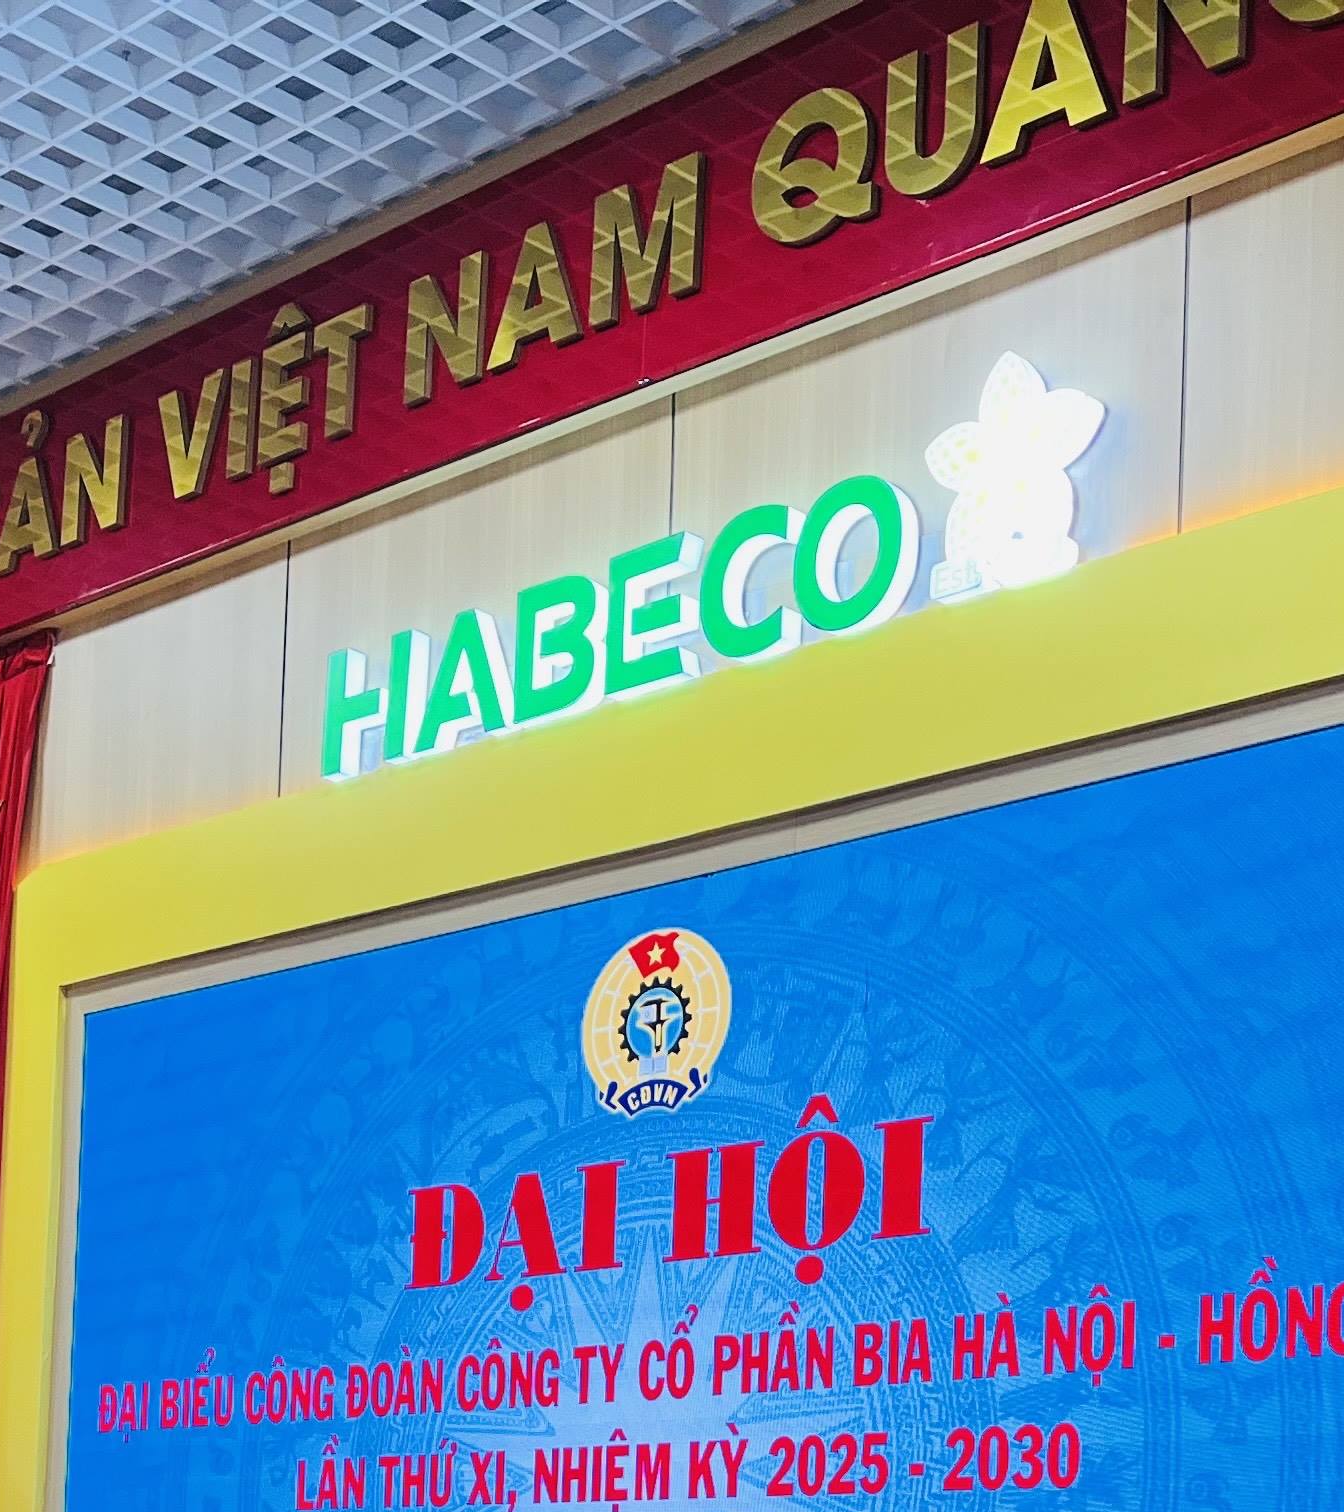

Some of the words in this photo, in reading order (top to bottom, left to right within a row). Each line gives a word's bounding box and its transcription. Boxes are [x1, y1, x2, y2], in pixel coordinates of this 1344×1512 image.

[158, 302, 373, 500] VIỆT
[404, 151, 704, 407] NAM
[320, 474, 918, 781] HABECO
[404, 1159, 627, 1312] ĐẠI
[663, 1093, 936, 1286] HỘI
[98, 1383, 149, 1443] ĐẠI
[160, 1347, 235, 1429] BIỂU
[244, 1356, 335, 1425] CÔNG
[346, 1346, 444, 1420] ĐOÀN
[456, 1339, 560, 1413] CÔNG
[573, 1343, 625, 1405] TY
[638, 1304, 699, 1401] CỔ
[712, 1301, 835, 1396] PHẦN
[853, 1318, 933, 1388] BIA
[953, 1293, 1020, 1382] HÀ
[1044, 1284, 1136, 1387] NỘI
[1158, 1334, 1176, 1349] -
[296, 1433, 366, 1512] LẦN
[378, 1440, 457, 1507] THỨ
[688, 1422, 749, 1499] KỲ
[766, 1431, 890, 1498] 2025
[942, 1421, 1081, 1492] 2030
